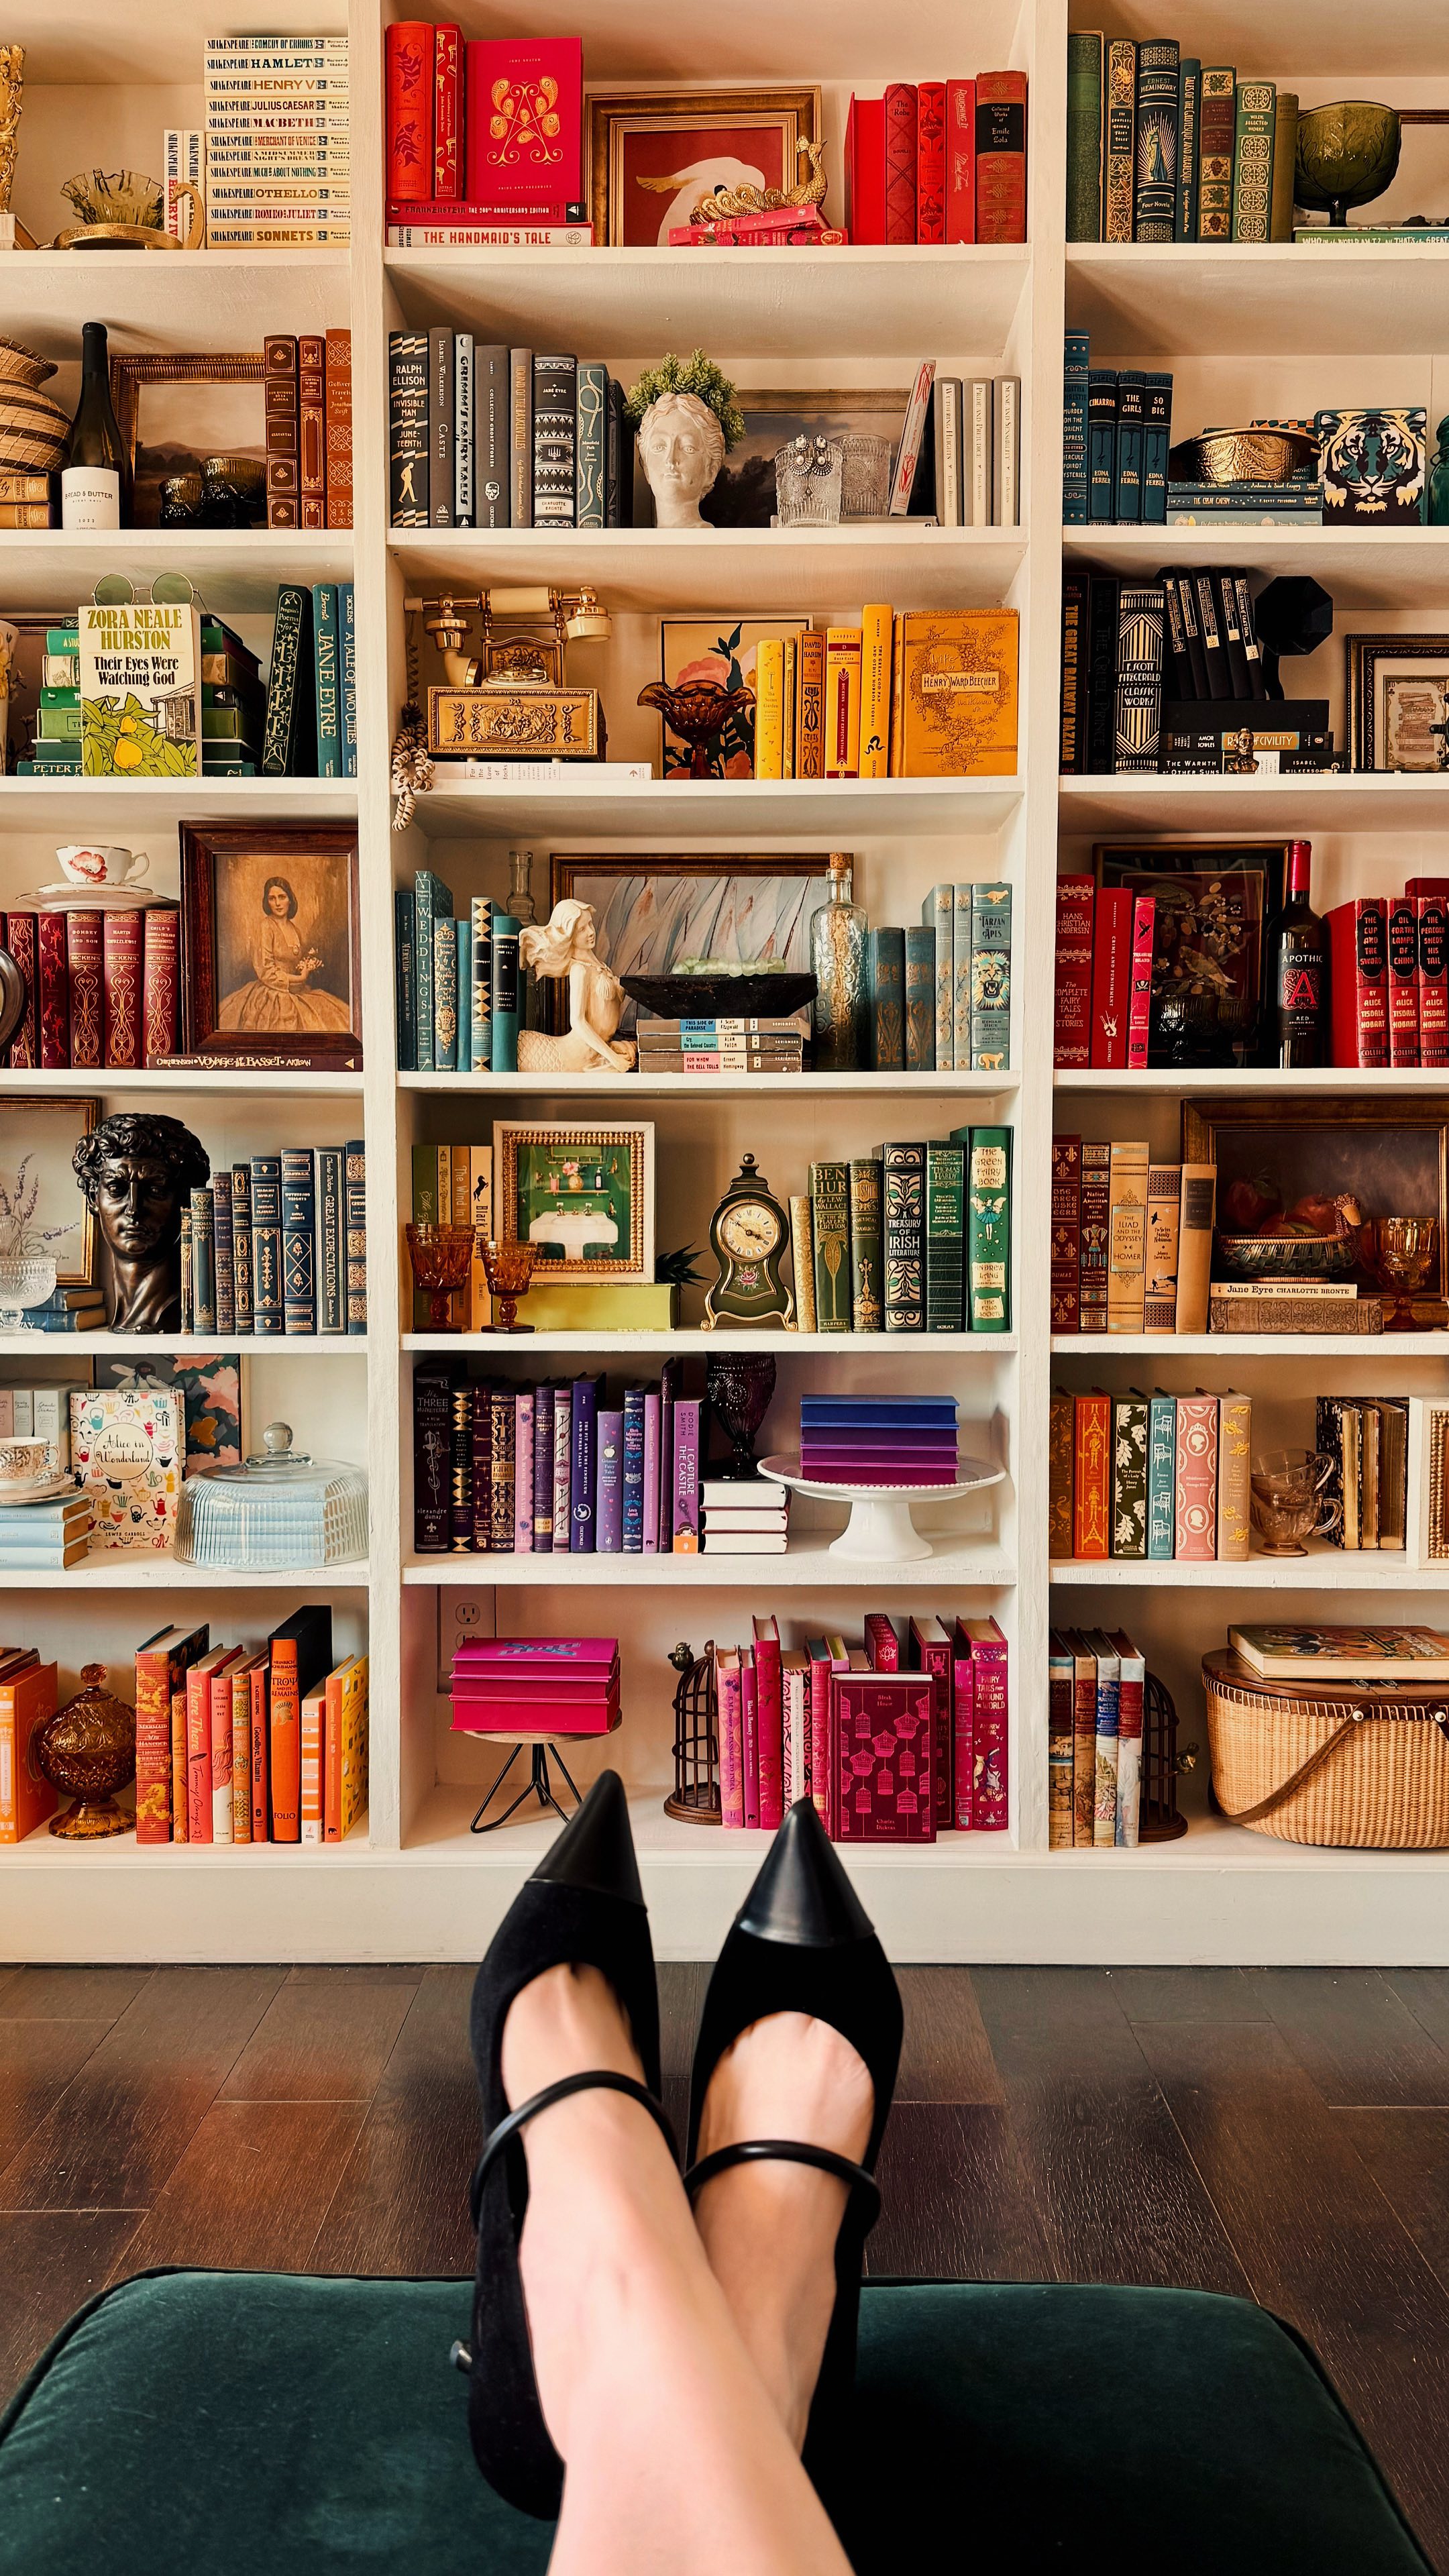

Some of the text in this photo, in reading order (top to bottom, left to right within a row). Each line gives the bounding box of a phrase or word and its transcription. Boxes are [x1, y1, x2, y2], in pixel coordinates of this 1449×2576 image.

[207, 58, 313, 69] SHAKESPEARE HAMLET
[211, 80, 315, 90] SHAKESPEARE HENRY V
[1140, 85, 1177, 93] HEMINGWAY
[209, 101, 314, 111] SHAKESPEARE JULIUS CAESAR
[953, 89, 967, 121] ROUGHING
[209, 118, 314, 127] SHAKESPEARE MACBETH
[190, 134, 199, 176] SHAKESPEARE
[212, 189, 317, 198] SHAKESPEARE OTHELLO
[211, 231, 313, 241] SHAKESPEARE SONNETS
[424, 231, 445, 244] THE
[450, 231, 520, 244] HANDMAID'S
[525, 232, 551, 244] TALE
[396, 365, 422, 374] RALPH
[392, 376, 425, 386] ELLISON
[1126, 394, 1140, 402] THE
[1153, 396, 1164, 405] SO
[393, 400, 425, 408] INVISIBLE
[1122, 405, 1142, 413] GIRLS
[1151, 407, 1165, 415] BIG
[399, 430, 421, 438] JUNE-
[65, 492, 81, 500] BREAD
[88, 491, 113, 500] BUTTER
[87, 608, 182, 629] ZORA NEALE
[101, 631, 170, 650] HURSTON
[930, 653, 956, 664] Life
[94, 656, 179, 672] Their Eyes Were
[98, 671, 175, 688] Watching God
[924, 676, 997, 689] HENRY WARD BEECHER
[1062, 605, 1079, 761] THE GREAT RAILWAY BAZAAR
[1118, 674, 1161, 683] FITZGERALD
[319, 629, 337, 739] JANE EYRE
[1124, 688, 1155, 696] CLASSIC
[1124, 698, 1155, 706] WORKS
[34, 765, 71, 773] PETER
[979, 915, 1006, 926] TARZAN
[1364, 916, 1377, 924] THE
[1399, 916, 1409, 924] OIL
[982, 929, 1002, 940] APES
[1364, 926, 1378, 934] CUP
[1392, 936, 1414, 944] LAMPS
[1282, 955, 1324, 964] APOTHIC
[1364, 998, 1382, 1006] ALICE
[1360, 1009, 1385, 1017] TISDALE
[1360, 1020, 1385, 1028] HOBART
[815, 1169, 845, 1180] BEN
[978, 1178, 1001, 1186] BOOK
[815, 1181, 846, 1194] HUR
[888, 1219, 921, 1228] TREASURY
[325, 1195, 336, 1297] GREAT EXPECTATIONS
[890, 1236, 920, 1249] IRISH
[1227, 1285, 1249, 1293] Jane
[1251, 1285, 1273, 1295] Eyre
[417, 1398, 449, 1407] THREE
[103, 1434, 145, 1451] Alice in
[95, 1450, 150, 1464] Wonderland
[678, 1445, 687, 1496] THE CASTLE
[271, 1677, 298, 1686] TROY
[977, 1693, 1004, 1701] AROUND
[191, 1683, 204, 1750] There There
